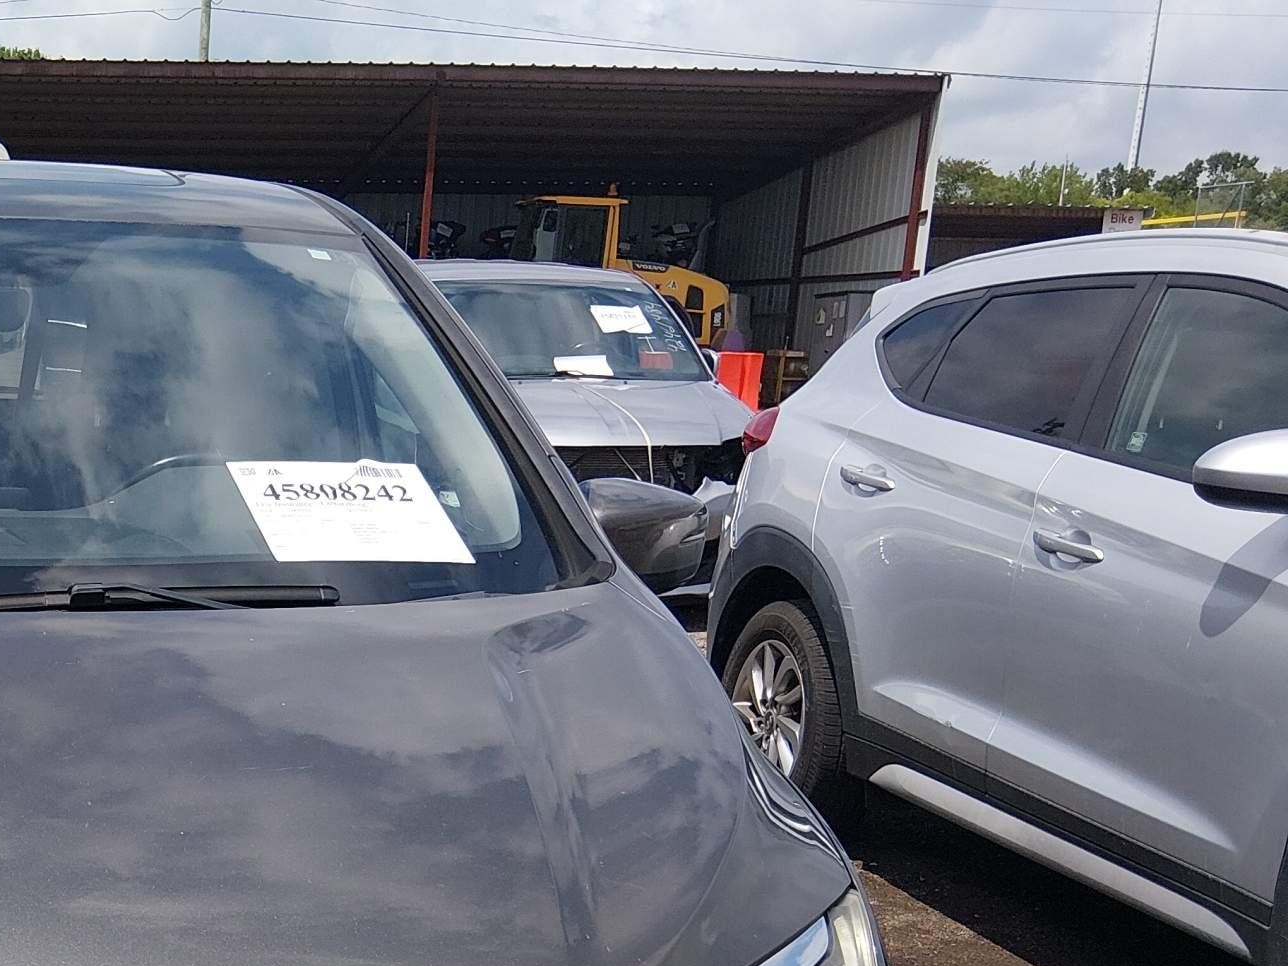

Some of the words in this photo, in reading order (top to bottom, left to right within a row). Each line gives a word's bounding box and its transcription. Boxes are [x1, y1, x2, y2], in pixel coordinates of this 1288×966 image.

[1110, 212, 1134, 224] Bike
[635, 263, 666, 271] VOLVO
[263, 482, 413, 502] 45808242
